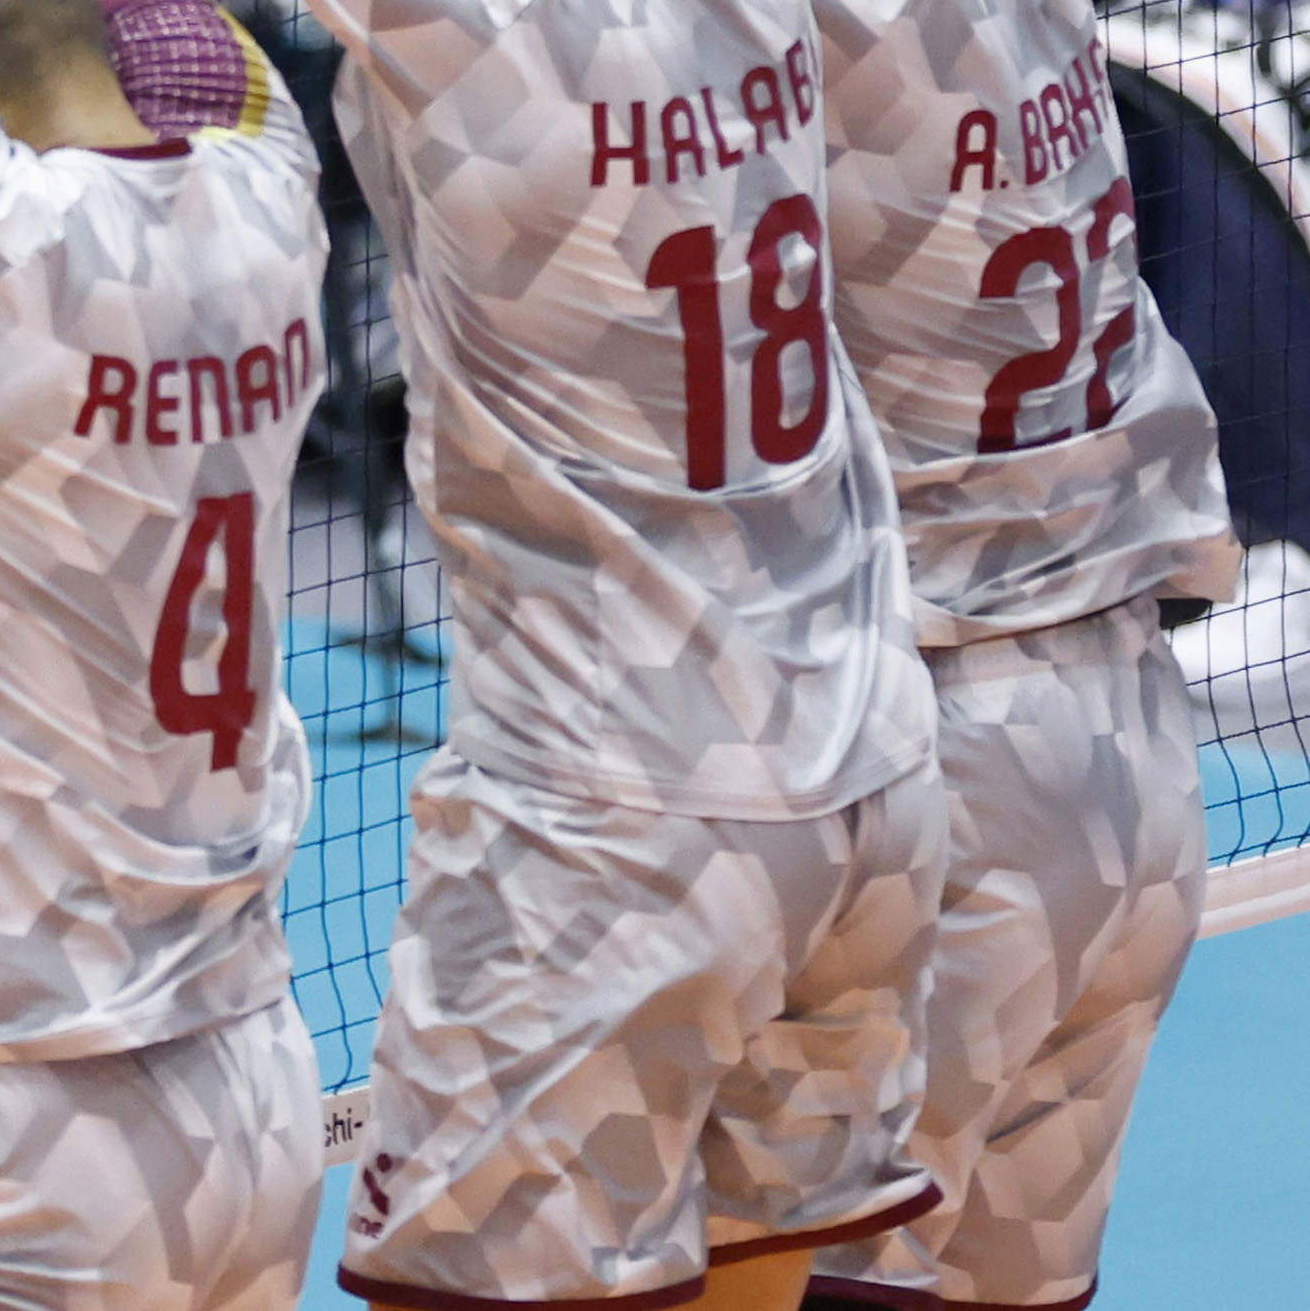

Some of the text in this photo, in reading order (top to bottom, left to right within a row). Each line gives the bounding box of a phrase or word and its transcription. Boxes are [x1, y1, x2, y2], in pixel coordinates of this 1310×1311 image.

[950, 109, 1009, 192] A.
[74, 317, 311, 446] RENAN
[645, 193, 829, 490] 18
[977, 175, 1138, 453] 22
[149, 491, 257, 774] 4
